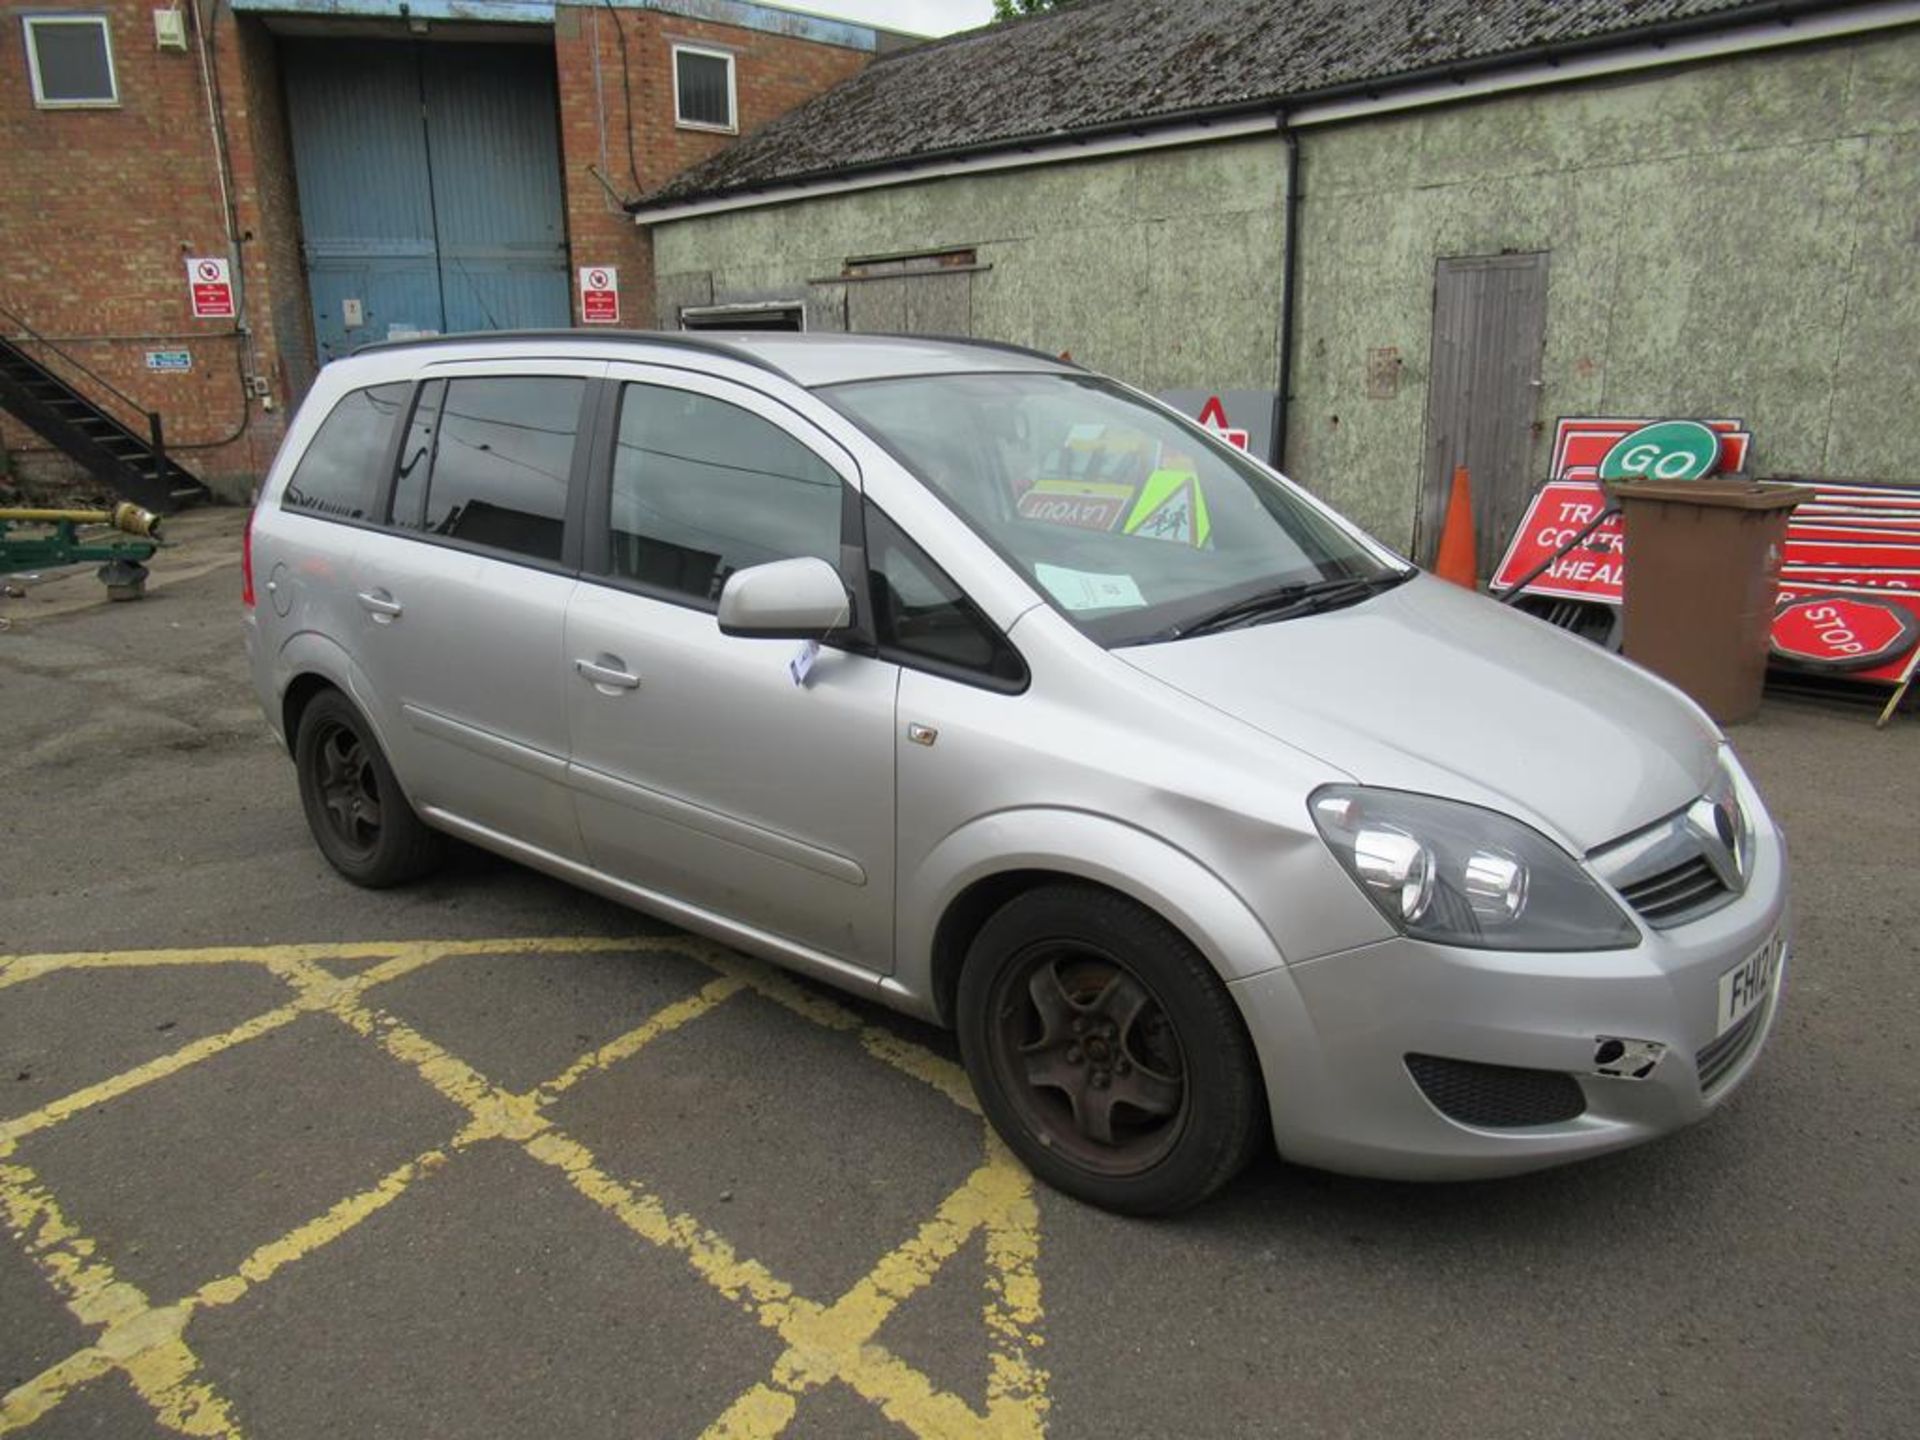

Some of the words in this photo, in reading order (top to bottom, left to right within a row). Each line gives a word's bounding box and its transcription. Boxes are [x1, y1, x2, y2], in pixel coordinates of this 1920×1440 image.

[1621, 444, 1696, 479] GO
[1025, 501, 1107, 523] LAYOUT
[1805, 606, 1863, 654] STOP
